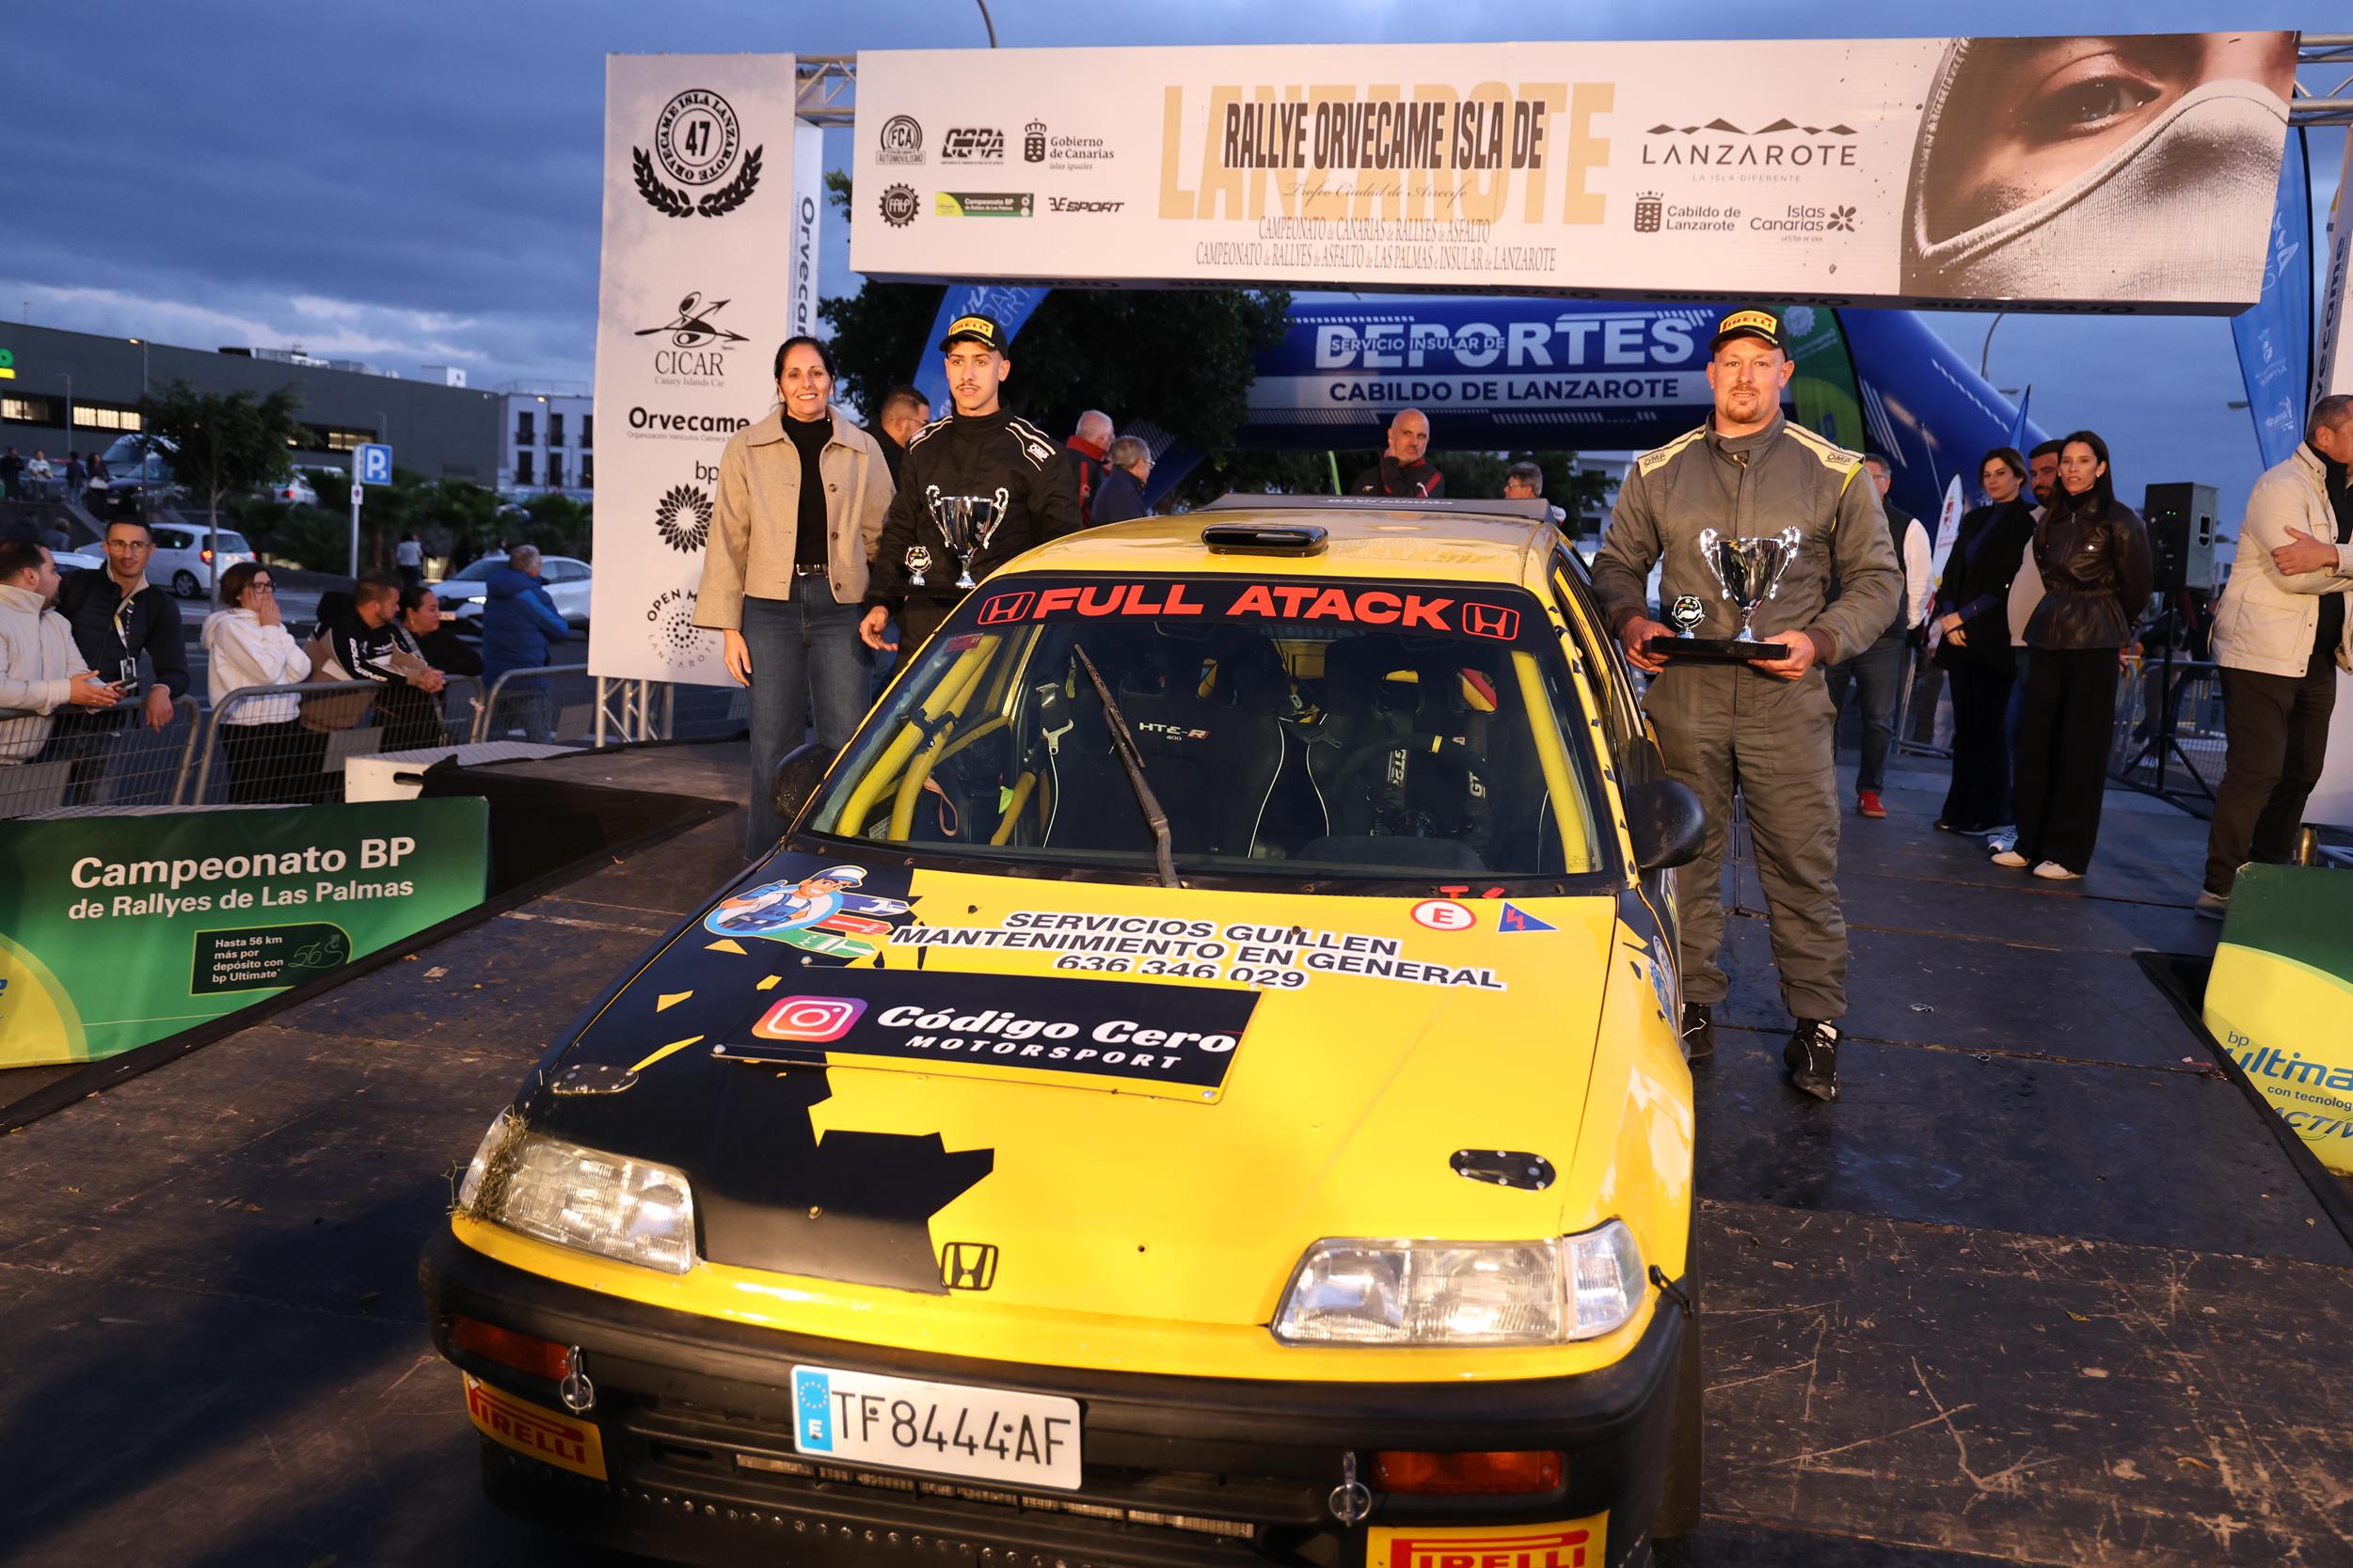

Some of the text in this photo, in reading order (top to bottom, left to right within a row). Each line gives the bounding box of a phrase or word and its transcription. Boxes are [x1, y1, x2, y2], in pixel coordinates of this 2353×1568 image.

[678, 93, 710, 108] ISLA
[660, 105, 694, 182] ORVECAME
[685, 120, 711, 156] 47
[699, 99, 737, 182] LANZAROTE
[891, 127, 913, 148] FCA
[1050, 135, 1104, 147] Gobierno
[1224, 101, 1546, 170] RALLYE ORVECAME ISLA DE
[1050, 148, 1115, 159] de Canarias
[1642, 143, 1858, 166] LANZAROTE
[1667, 205, 1741, 218] Cabildo de
[1787, 204, 1825, 218] Islas
[1259, 215, 1327, 240] CAMPEONATO
[1336, 216, 1386, 241] CANARIAS
[1395, 217, 1438, 242] RALLYES
[1446, 218, 1490, 243] ASFALTO
[1666, 219, 1735, 231] Lanzarote
[1749, 217, 1825, 232] Canarias
[1196, 242, 1263, 265] CAMPEONATO
[1272, 243, 1312, 267] RALLYES
[1323, 244, 1364, 268] ASFALTO
[1374, 245, 1393, 269] LAS
[1393, 245, 1434, 270] PALMAS
[1439, 245, 1483, 271] INSULAR
[1493, 246, 1557, 272] LANZAROTE
[1330, 336, 1505, 352] SERVICIO INSULAR DE
[655, 349, 724, 376] CICAR
[654, 376, 724, 388] Canary Islands Car
[1328, 378, 1679, 403] CABILDO DE LANZAROTE
[628, 405, 751, 433] Orvecame
[367, 448, 386, 479] P
[1644, 452, 1666, 466] OMP
[1825, 451, 1852, 466] OMP
[695, 460, 719, 484] bp
[646, 588, 681, 622] OPEN
[1032, 583, 1456, 632] FULL ATACK
[71, 836, 417, 890] Campeonato BP
[68, 876, 415, 920] de Rallyes de Las Palmas
[1432, 907, 1455, 925] E
[215, 935, 283, 948] Hasta 56 km
[1005, 911, 1401, 958] SERVICIOS GUILLEN
[214, 949, 260, 961] más por
[891, 925, 1506, 990] MANTENIMIENTO EN GENERAL
[213, 960, 262, 974] depósito
[1055, 954, 1311, 990] 636 346 029
[212, 974, 227, 985] bp
[877, 1004, 1236, 1053] Código Cero
[2227, 1030, 2250, 1048] bp
[904, 1034, 1183, 1070] MOTORSPORT
[2266, 1085, 2291, 1099] con
[468, 1382, 587, 1465] PIRELLI
[808, 1418, 823, 1439] E
